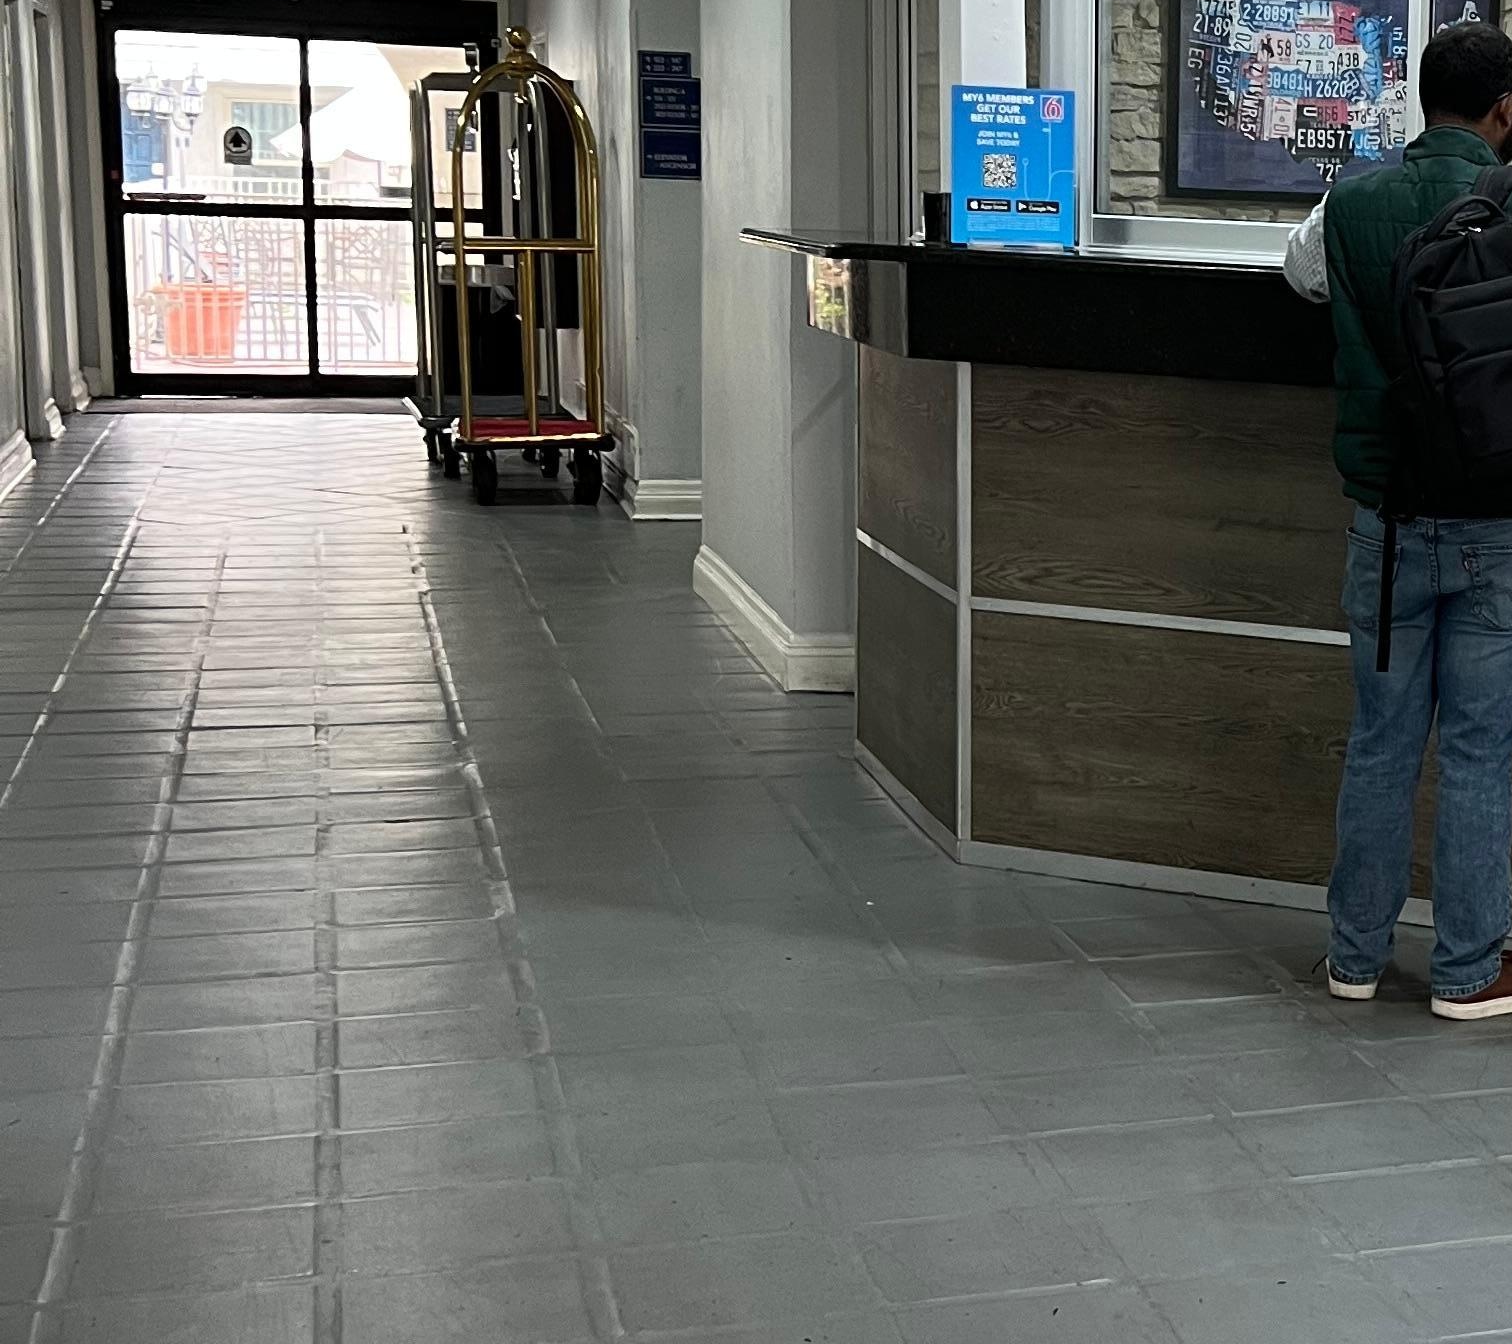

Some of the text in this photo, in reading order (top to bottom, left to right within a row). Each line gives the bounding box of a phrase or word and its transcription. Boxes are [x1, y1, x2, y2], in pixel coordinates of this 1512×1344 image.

[962, 93, 1034, 105] MY6 MEMBERS
[976, 104, 1021, 114] GET OUR
[970, 114, 1026, 125] BEST RATES
